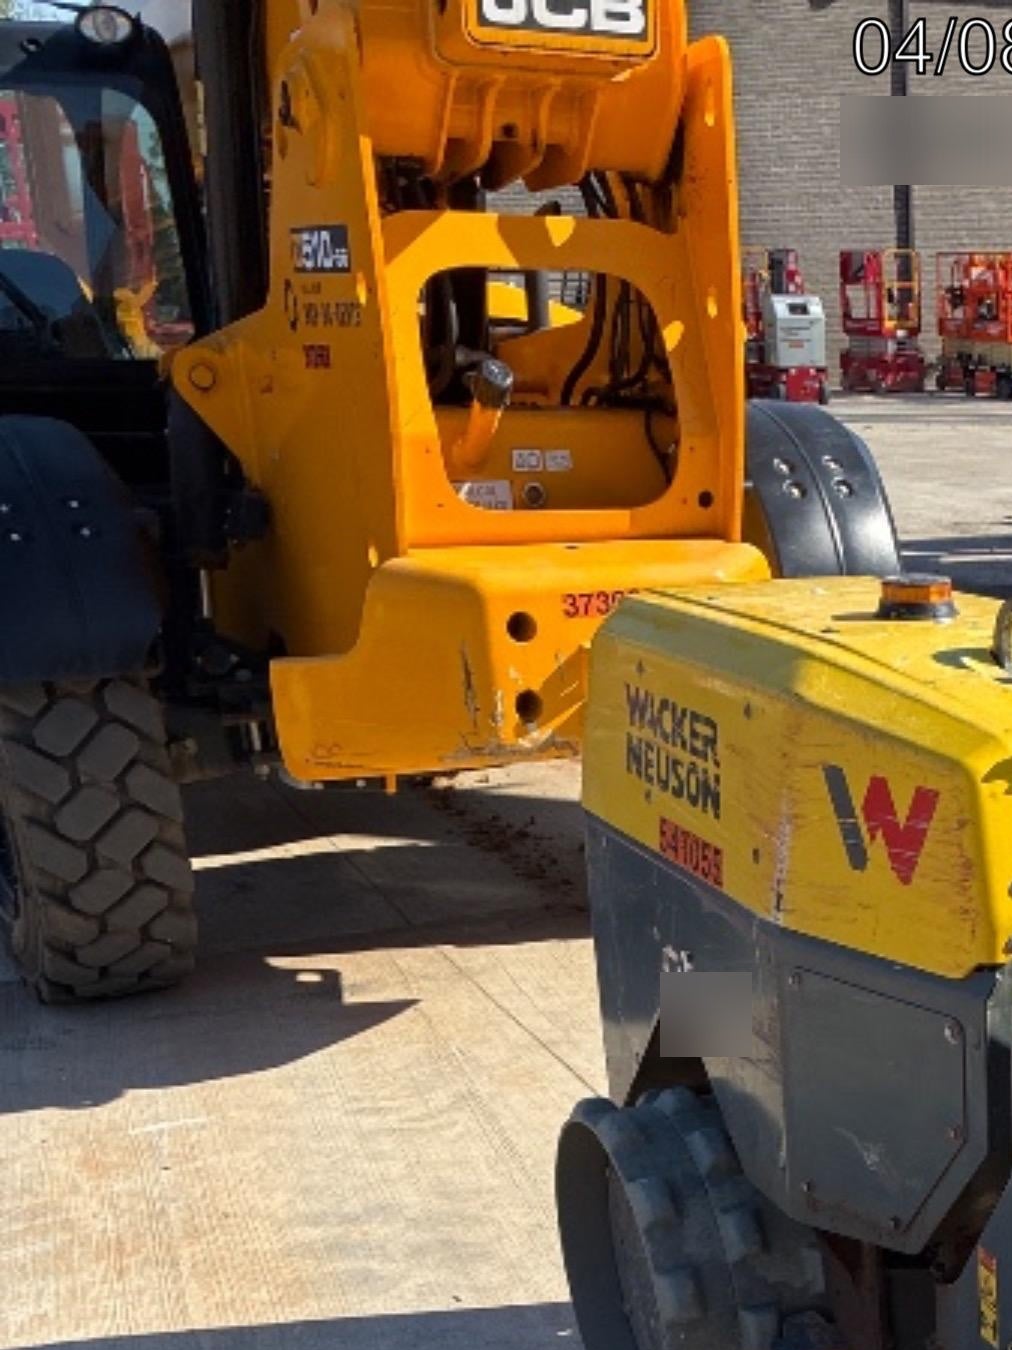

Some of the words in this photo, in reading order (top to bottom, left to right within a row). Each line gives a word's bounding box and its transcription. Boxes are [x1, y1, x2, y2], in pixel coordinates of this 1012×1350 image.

[483, 0, 646, 34] JCB
[624, 683, 720, 768] WACKER
[626, 732, 720, 819] NEUSON
